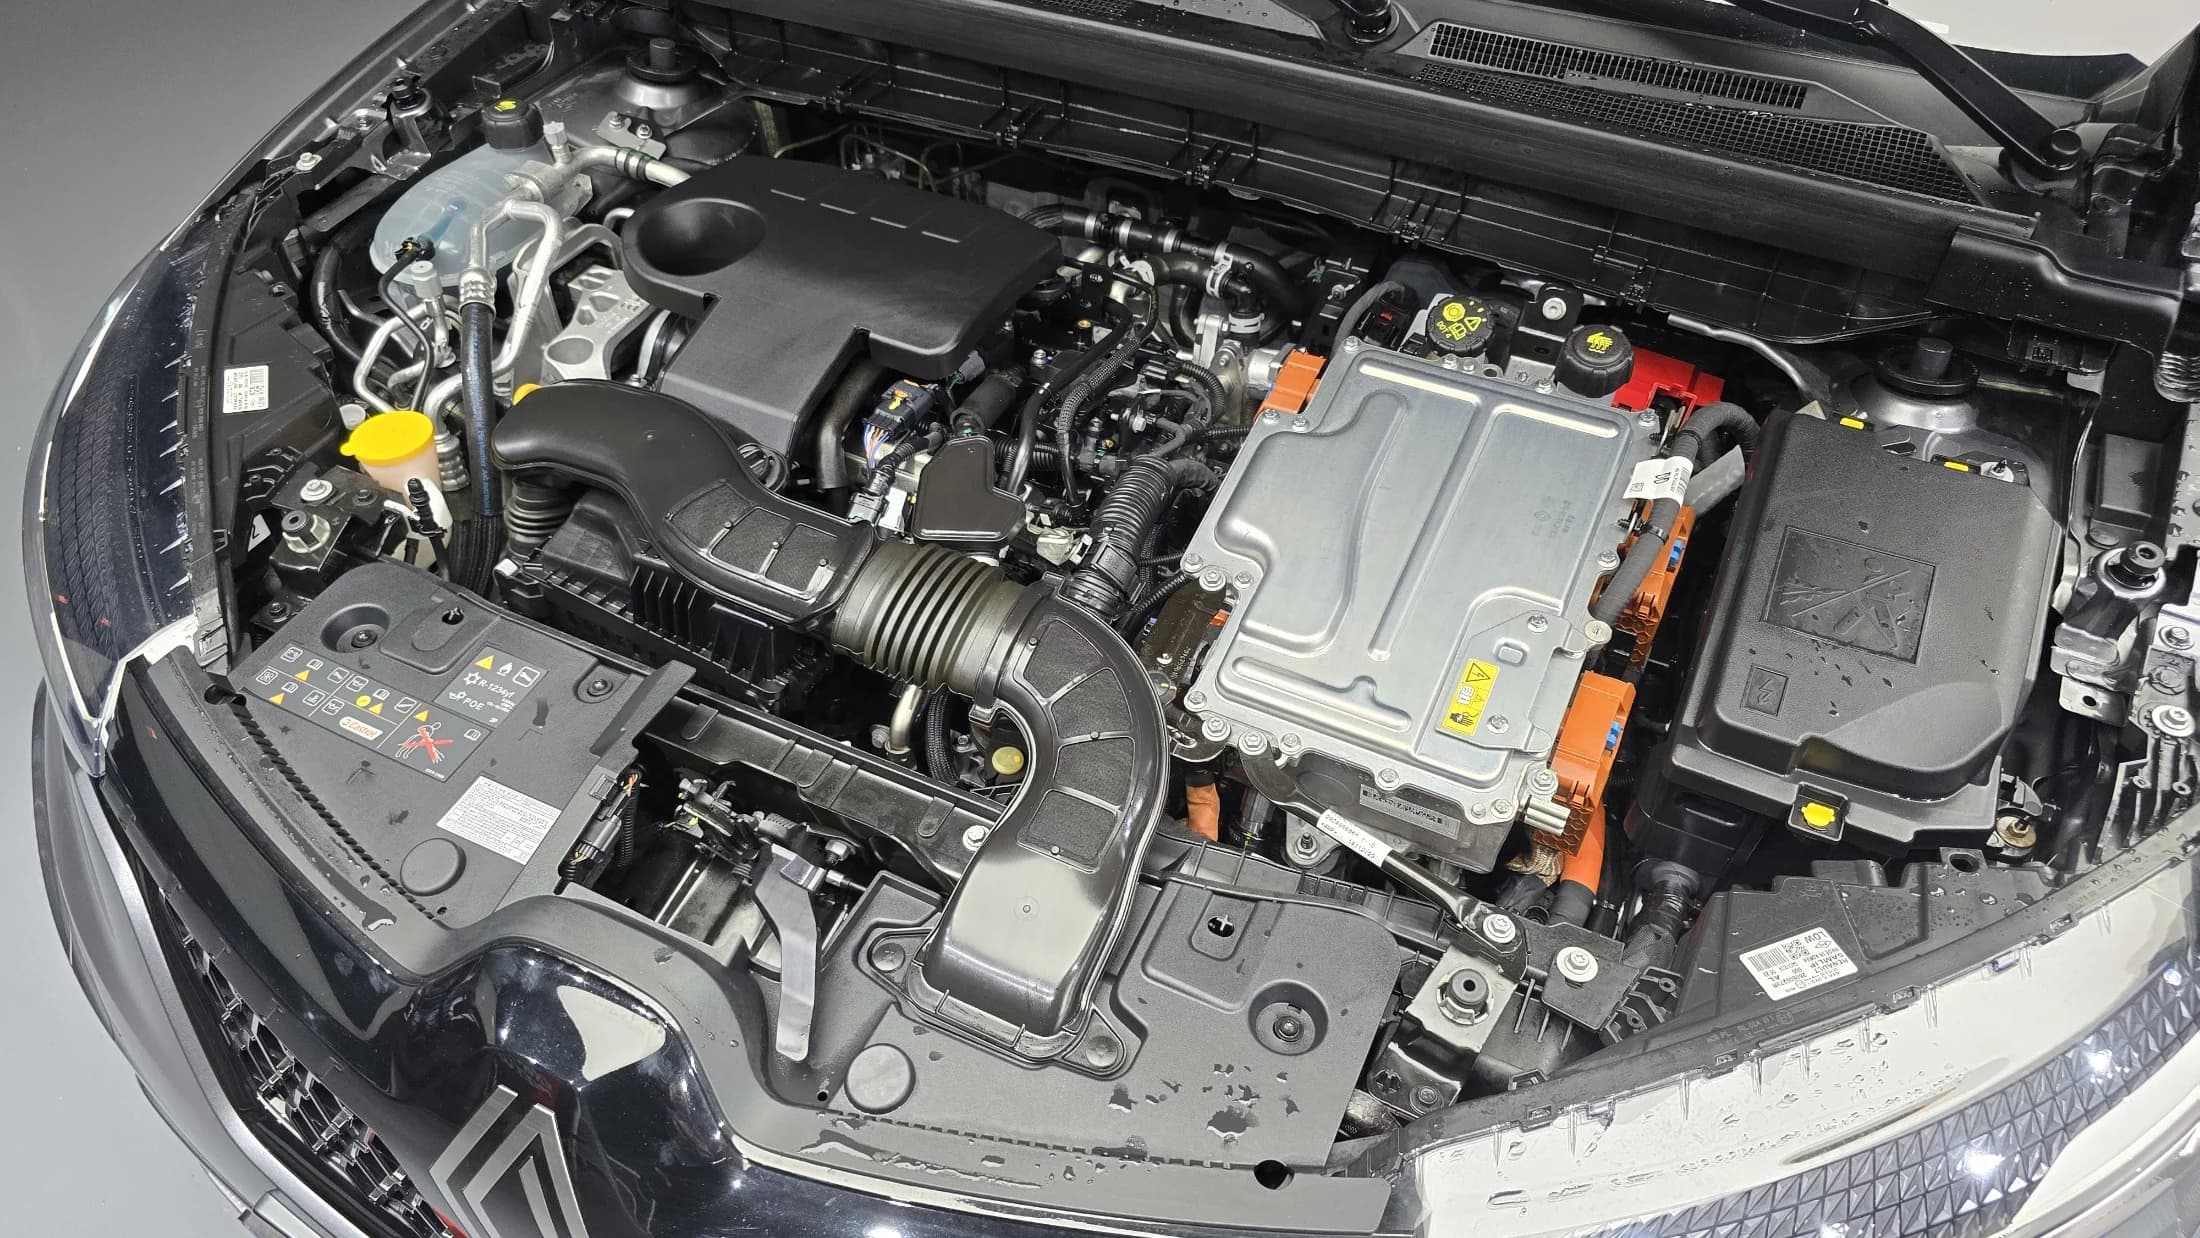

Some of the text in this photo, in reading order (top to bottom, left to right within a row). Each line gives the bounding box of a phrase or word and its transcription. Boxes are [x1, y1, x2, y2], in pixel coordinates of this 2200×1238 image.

[1437, 321, 1449, 333] DOT
[478, 679, 515, 698] R-1234yf
[463, 697, 484, 710] POE
[1804, 931, 1827, 943] LOW
[1810, 952, 1844, 968] SAMLIP
[1814, 957, 1848, 973] RENAULT
